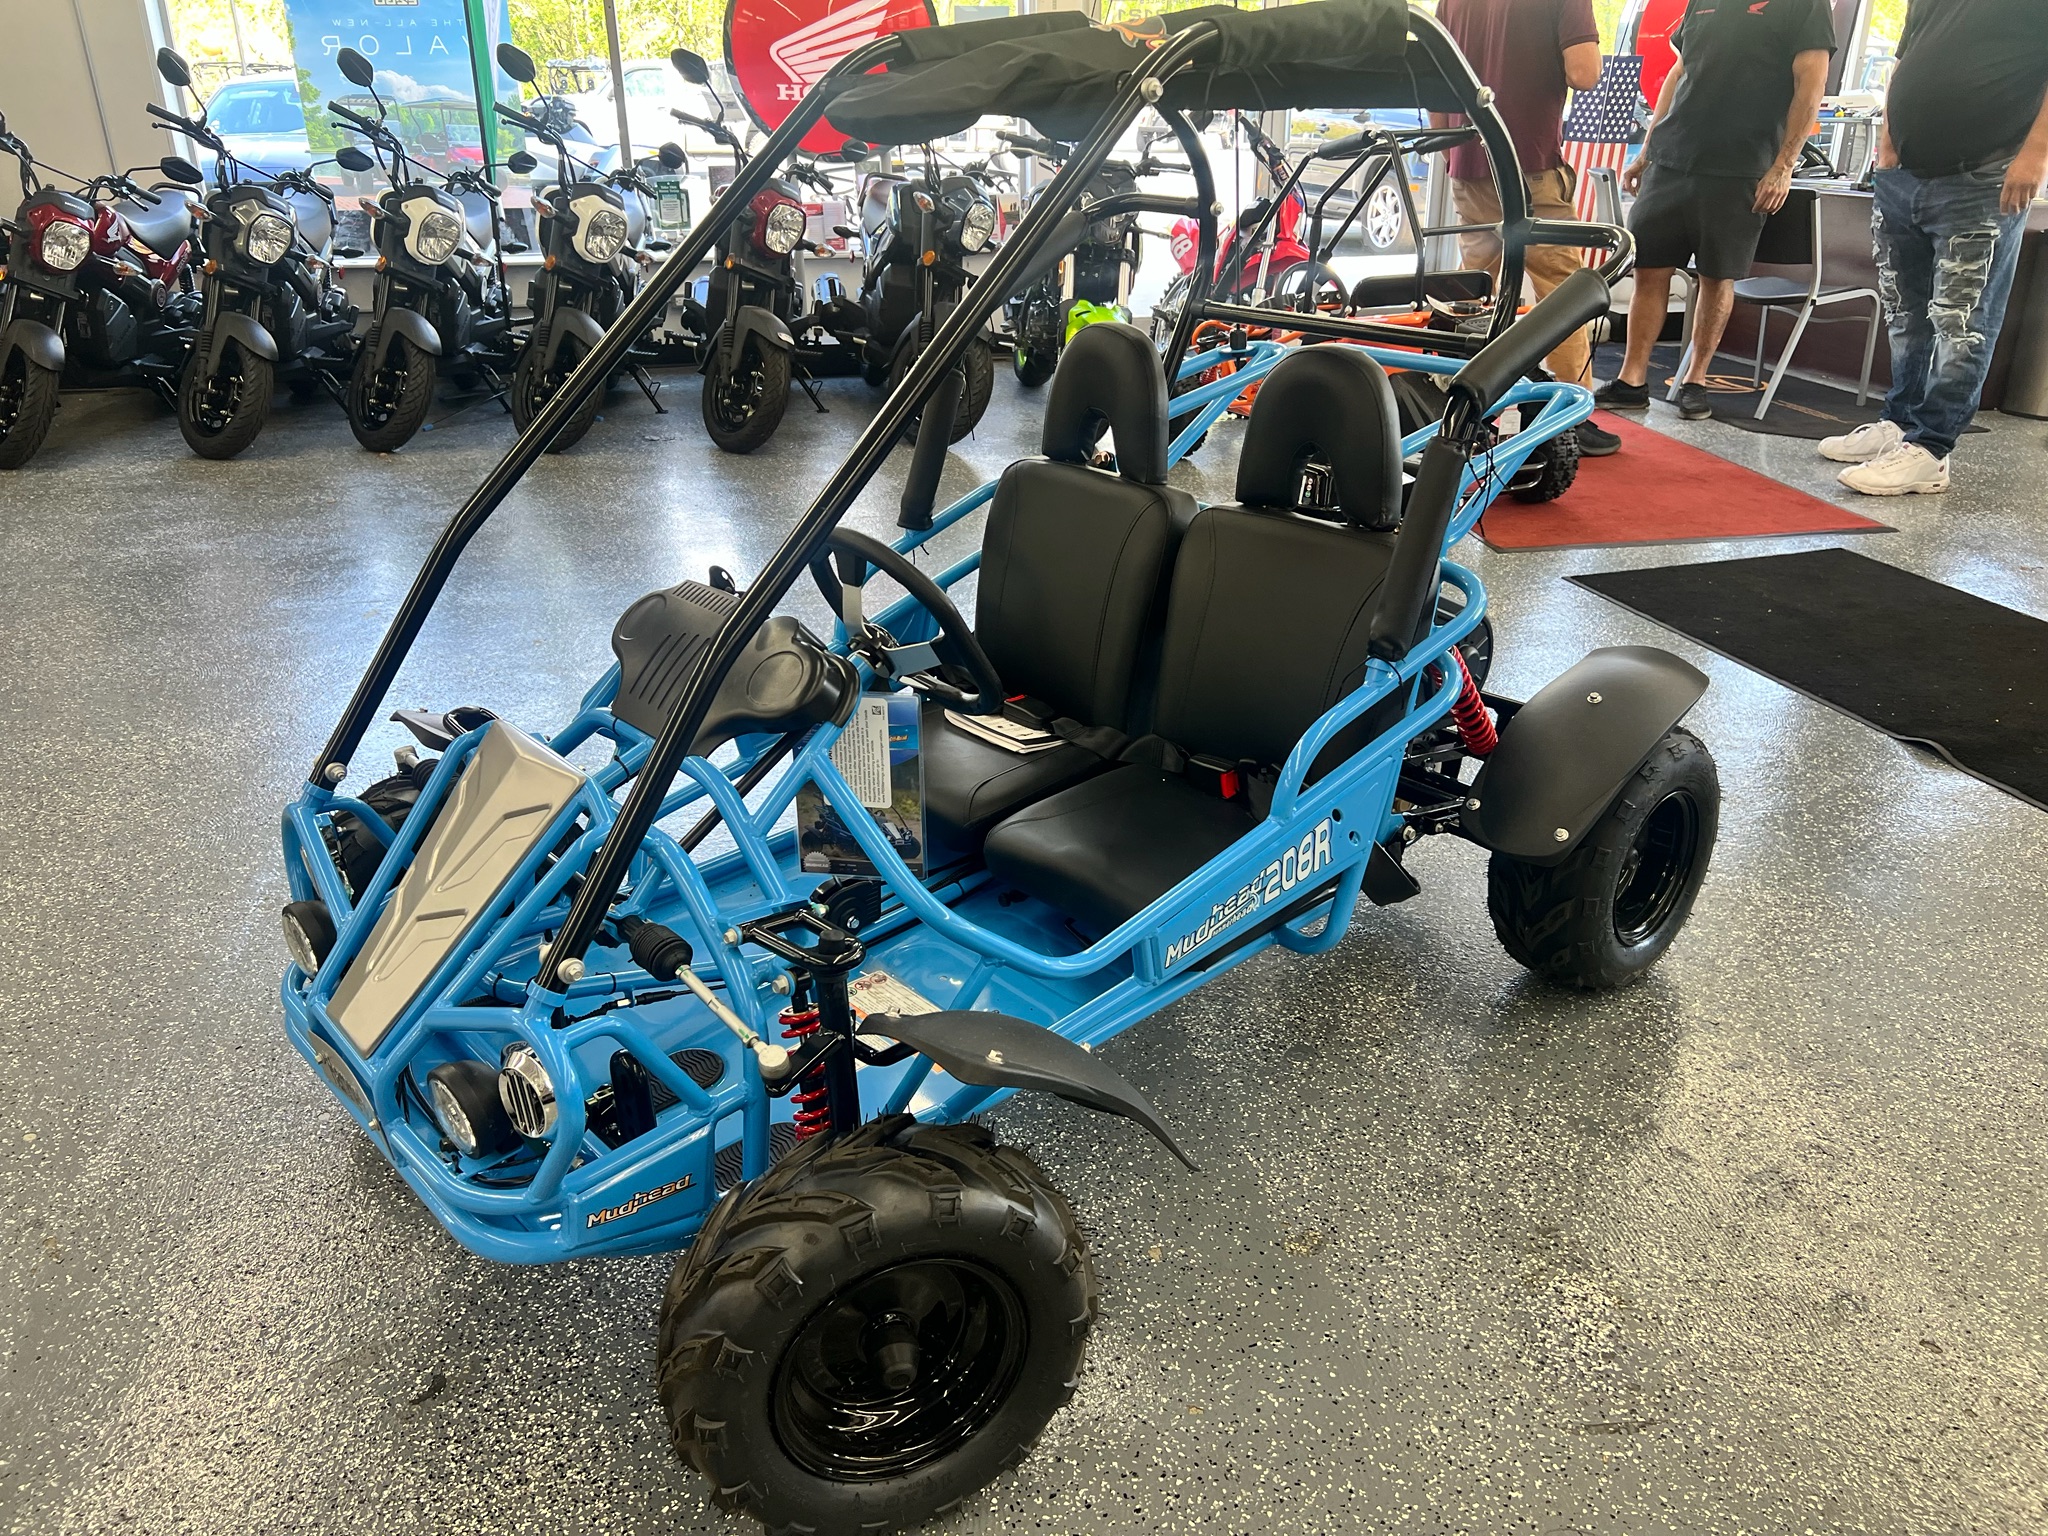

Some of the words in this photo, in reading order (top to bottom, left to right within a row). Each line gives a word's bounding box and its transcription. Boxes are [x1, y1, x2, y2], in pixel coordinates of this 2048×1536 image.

[1164, 869, 1267, 969] Mudhead
[1263, 816, 1333, 906] 208R
[586, 1173, 697, 1229] Mudhead
